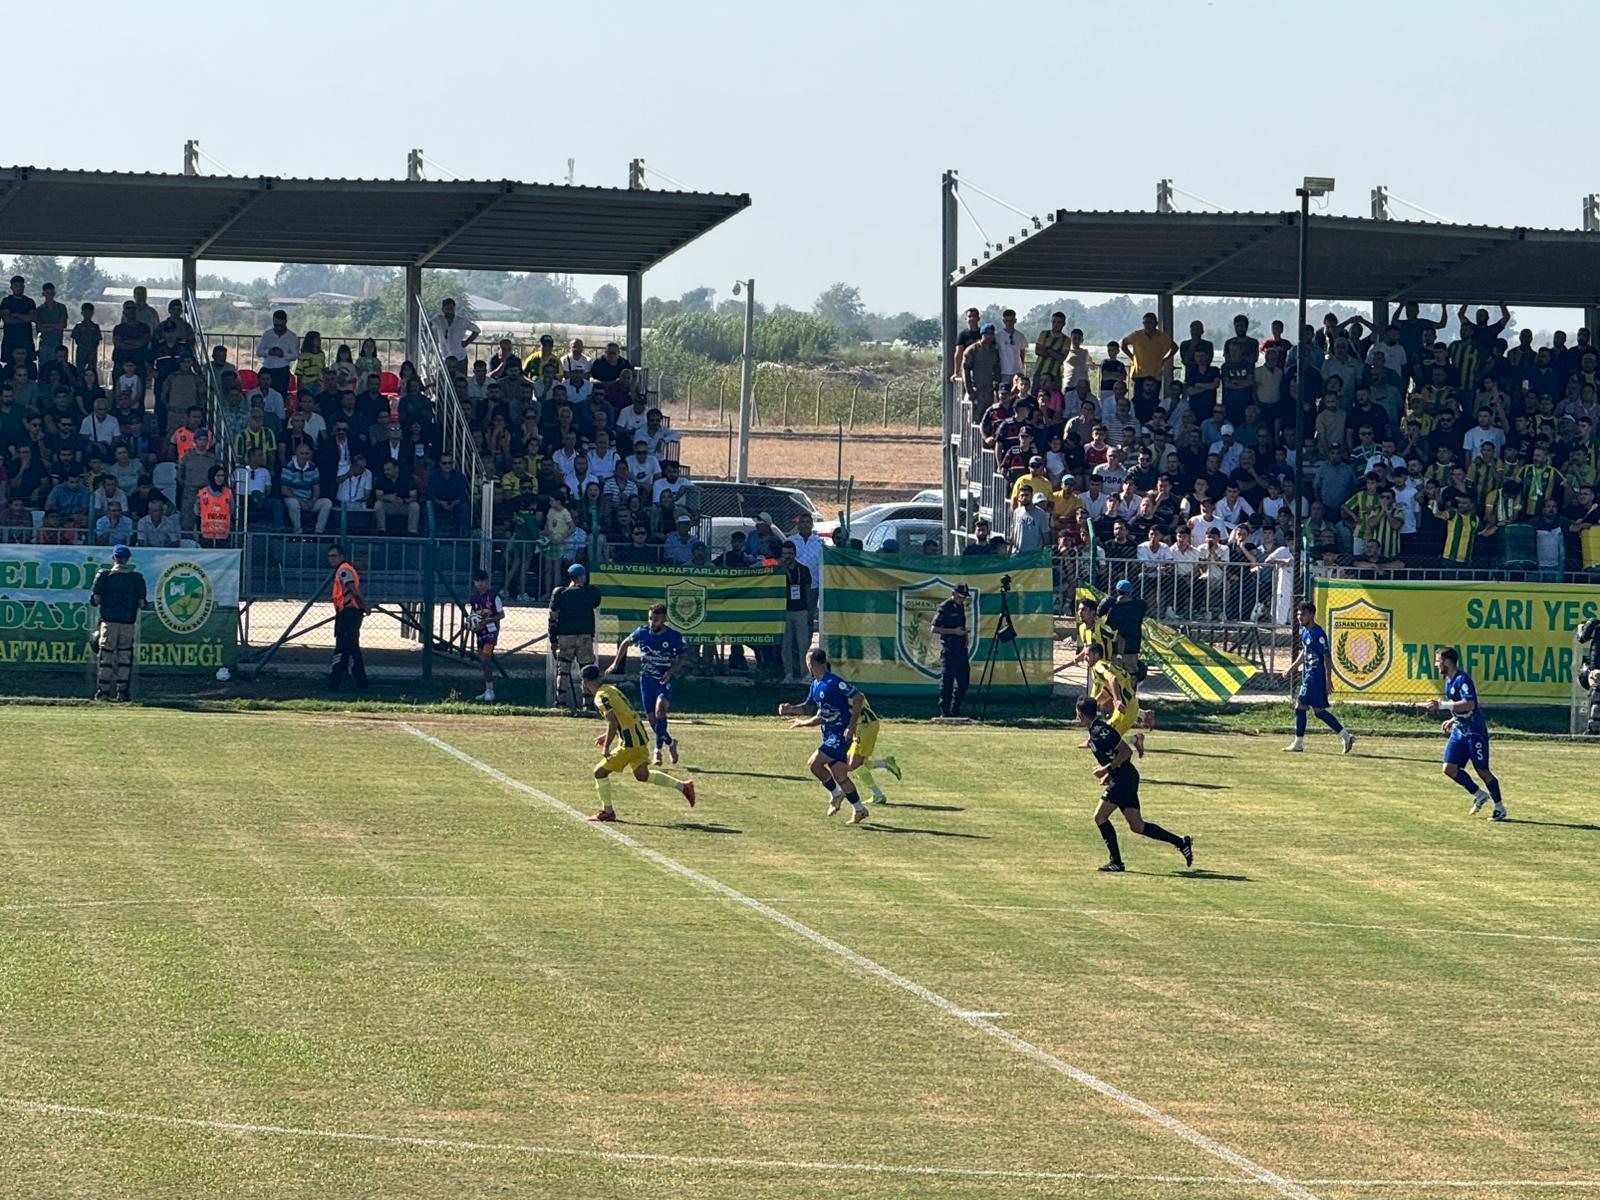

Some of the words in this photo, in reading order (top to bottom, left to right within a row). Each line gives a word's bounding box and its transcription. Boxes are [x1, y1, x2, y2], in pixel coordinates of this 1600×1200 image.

[0, 556, 136, 589] ELDİ
[656, 566, 729, 576] TARAFTARLAR
[1467, 598, 1532, 630] SARI
[0, 641, 98, 663] AFTARLA
[136, 637, 224, 666] ERNEĞİ
